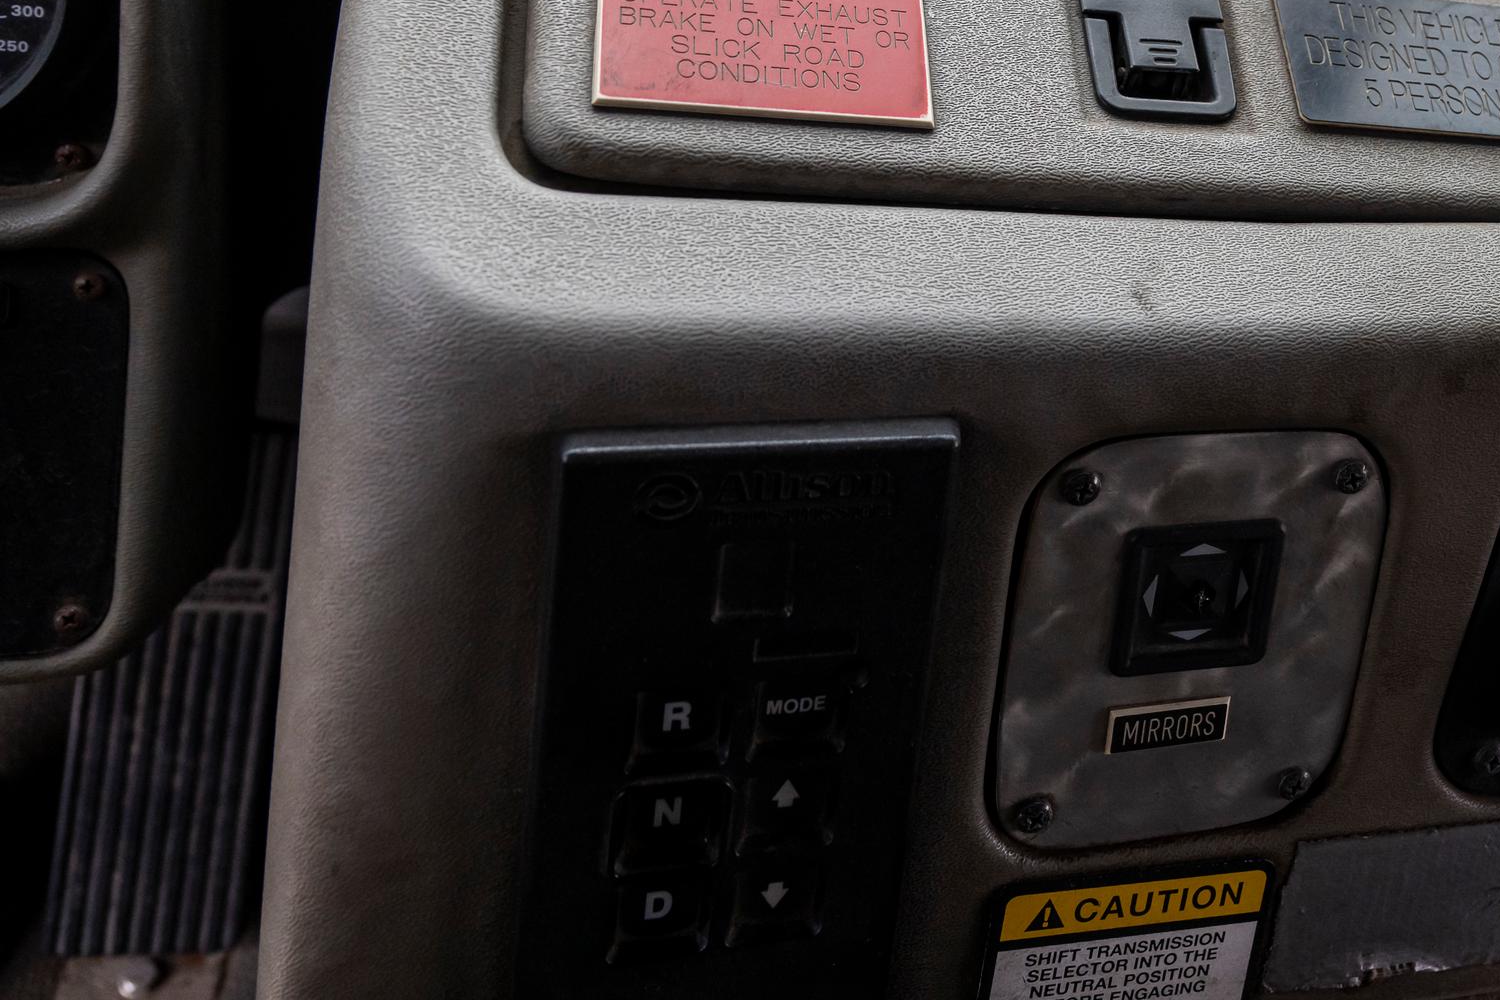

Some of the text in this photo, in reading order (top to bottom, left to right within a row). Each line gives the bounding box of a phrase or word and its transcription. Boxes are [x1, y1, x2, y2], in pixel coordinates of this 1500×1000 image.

[11, 4, 44, 19] 300
[619, 6, 910, 51] BRAKE ON WET OR
[1328, 0, 1396, 35] THIS
[671, 34, 865, 69] SLICK ROAD
[1304, 33, 1449, 76] DESIGNED
[1451, 49, 1494, 81] TO
[676, 58, 862, 92] CONDITIONS
[1364, 78, 1382, 107] 5
[662, 700, 693, 732] R
[765, 695, 827, 715] MODE
[1121, 711, 1216, 746] MIRRORS
[652, 796, 683, 828] N
[643, 890, 673, 920] D
[1074, 881, 1245, 923] CAUTION
[1025, 931, 1226, 967] SHIFT TRANSMISSION
[1026, 947, 1218, 983] SELECTOR INTO THE
[1029, 964, 1210, 999] NEUTRAL POSITION
[1109, 979, 1206, 1000] ENGAGING
